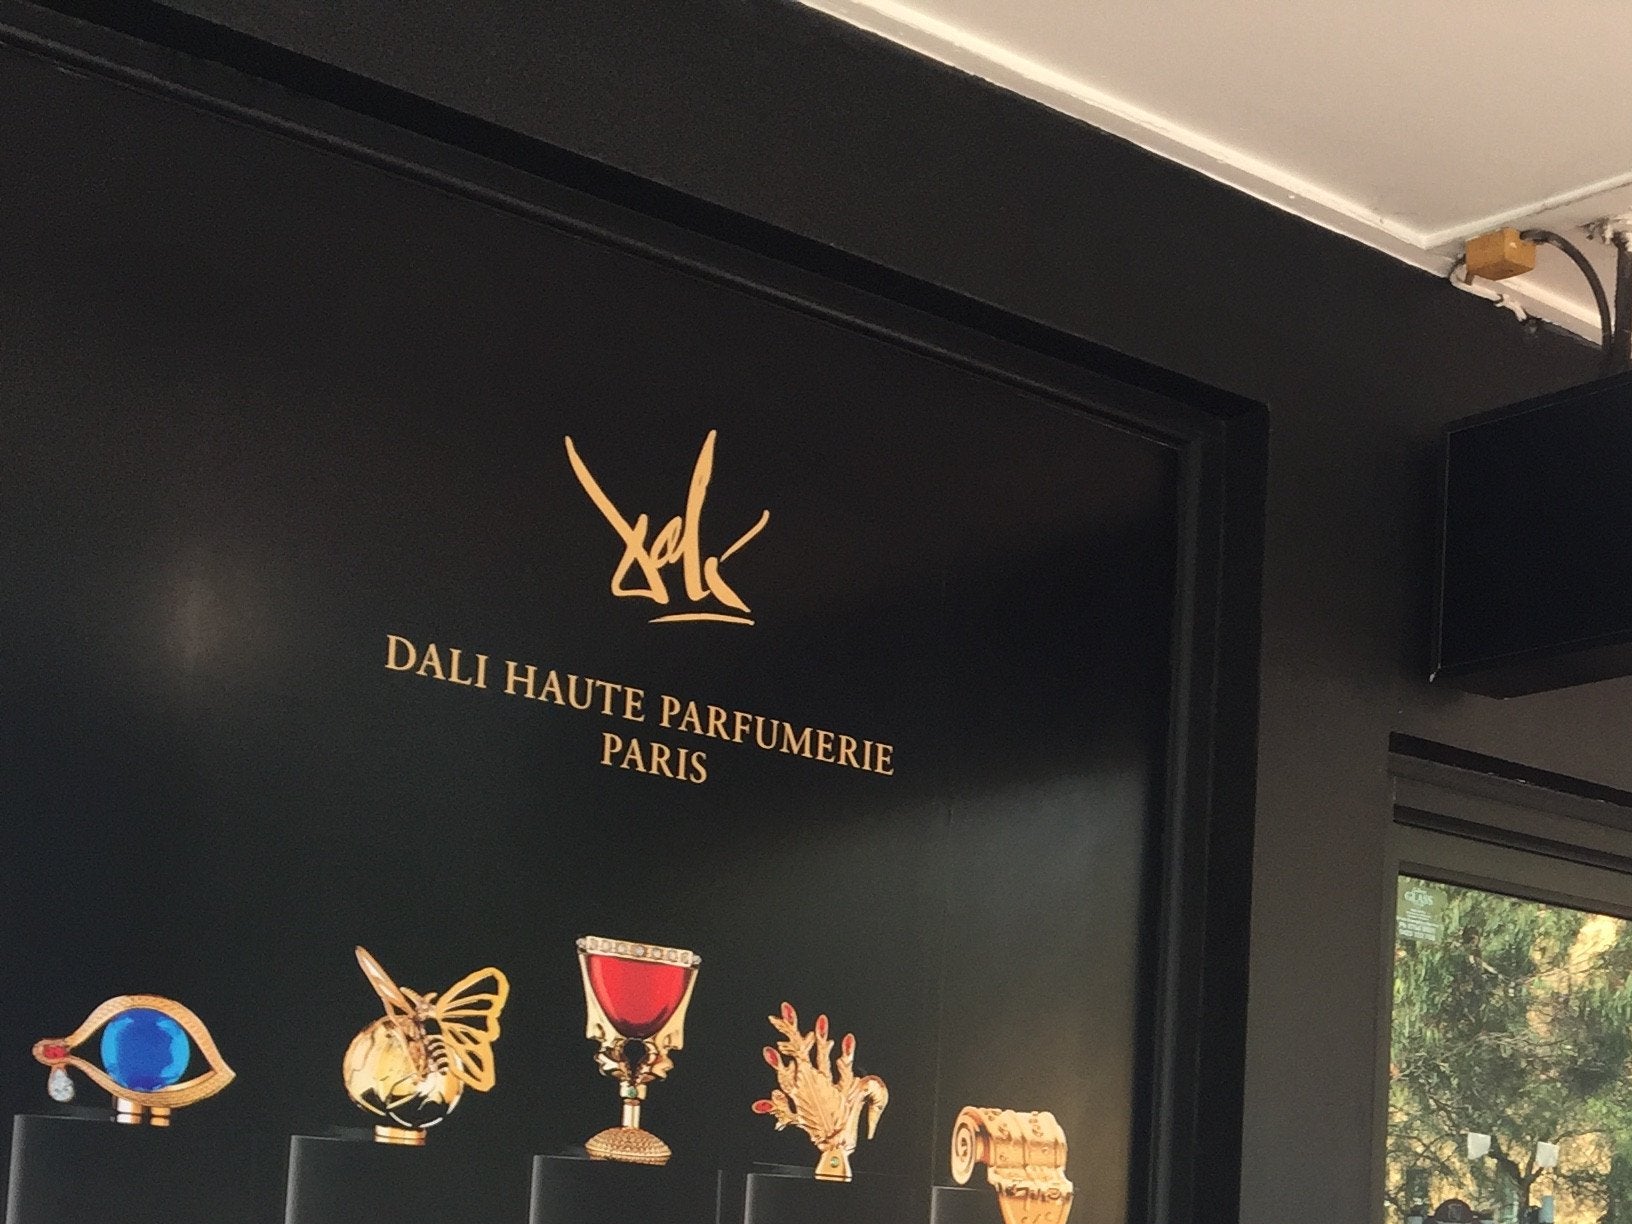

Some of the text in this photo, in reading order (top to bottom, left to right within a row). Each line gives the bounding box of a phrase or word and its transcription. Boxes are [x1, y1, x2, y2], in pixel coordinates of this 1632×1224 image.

[384, 634, 895, 776] DALI HAUTE PARFUMERIE
[600, 732, 709, 784] PARIS
